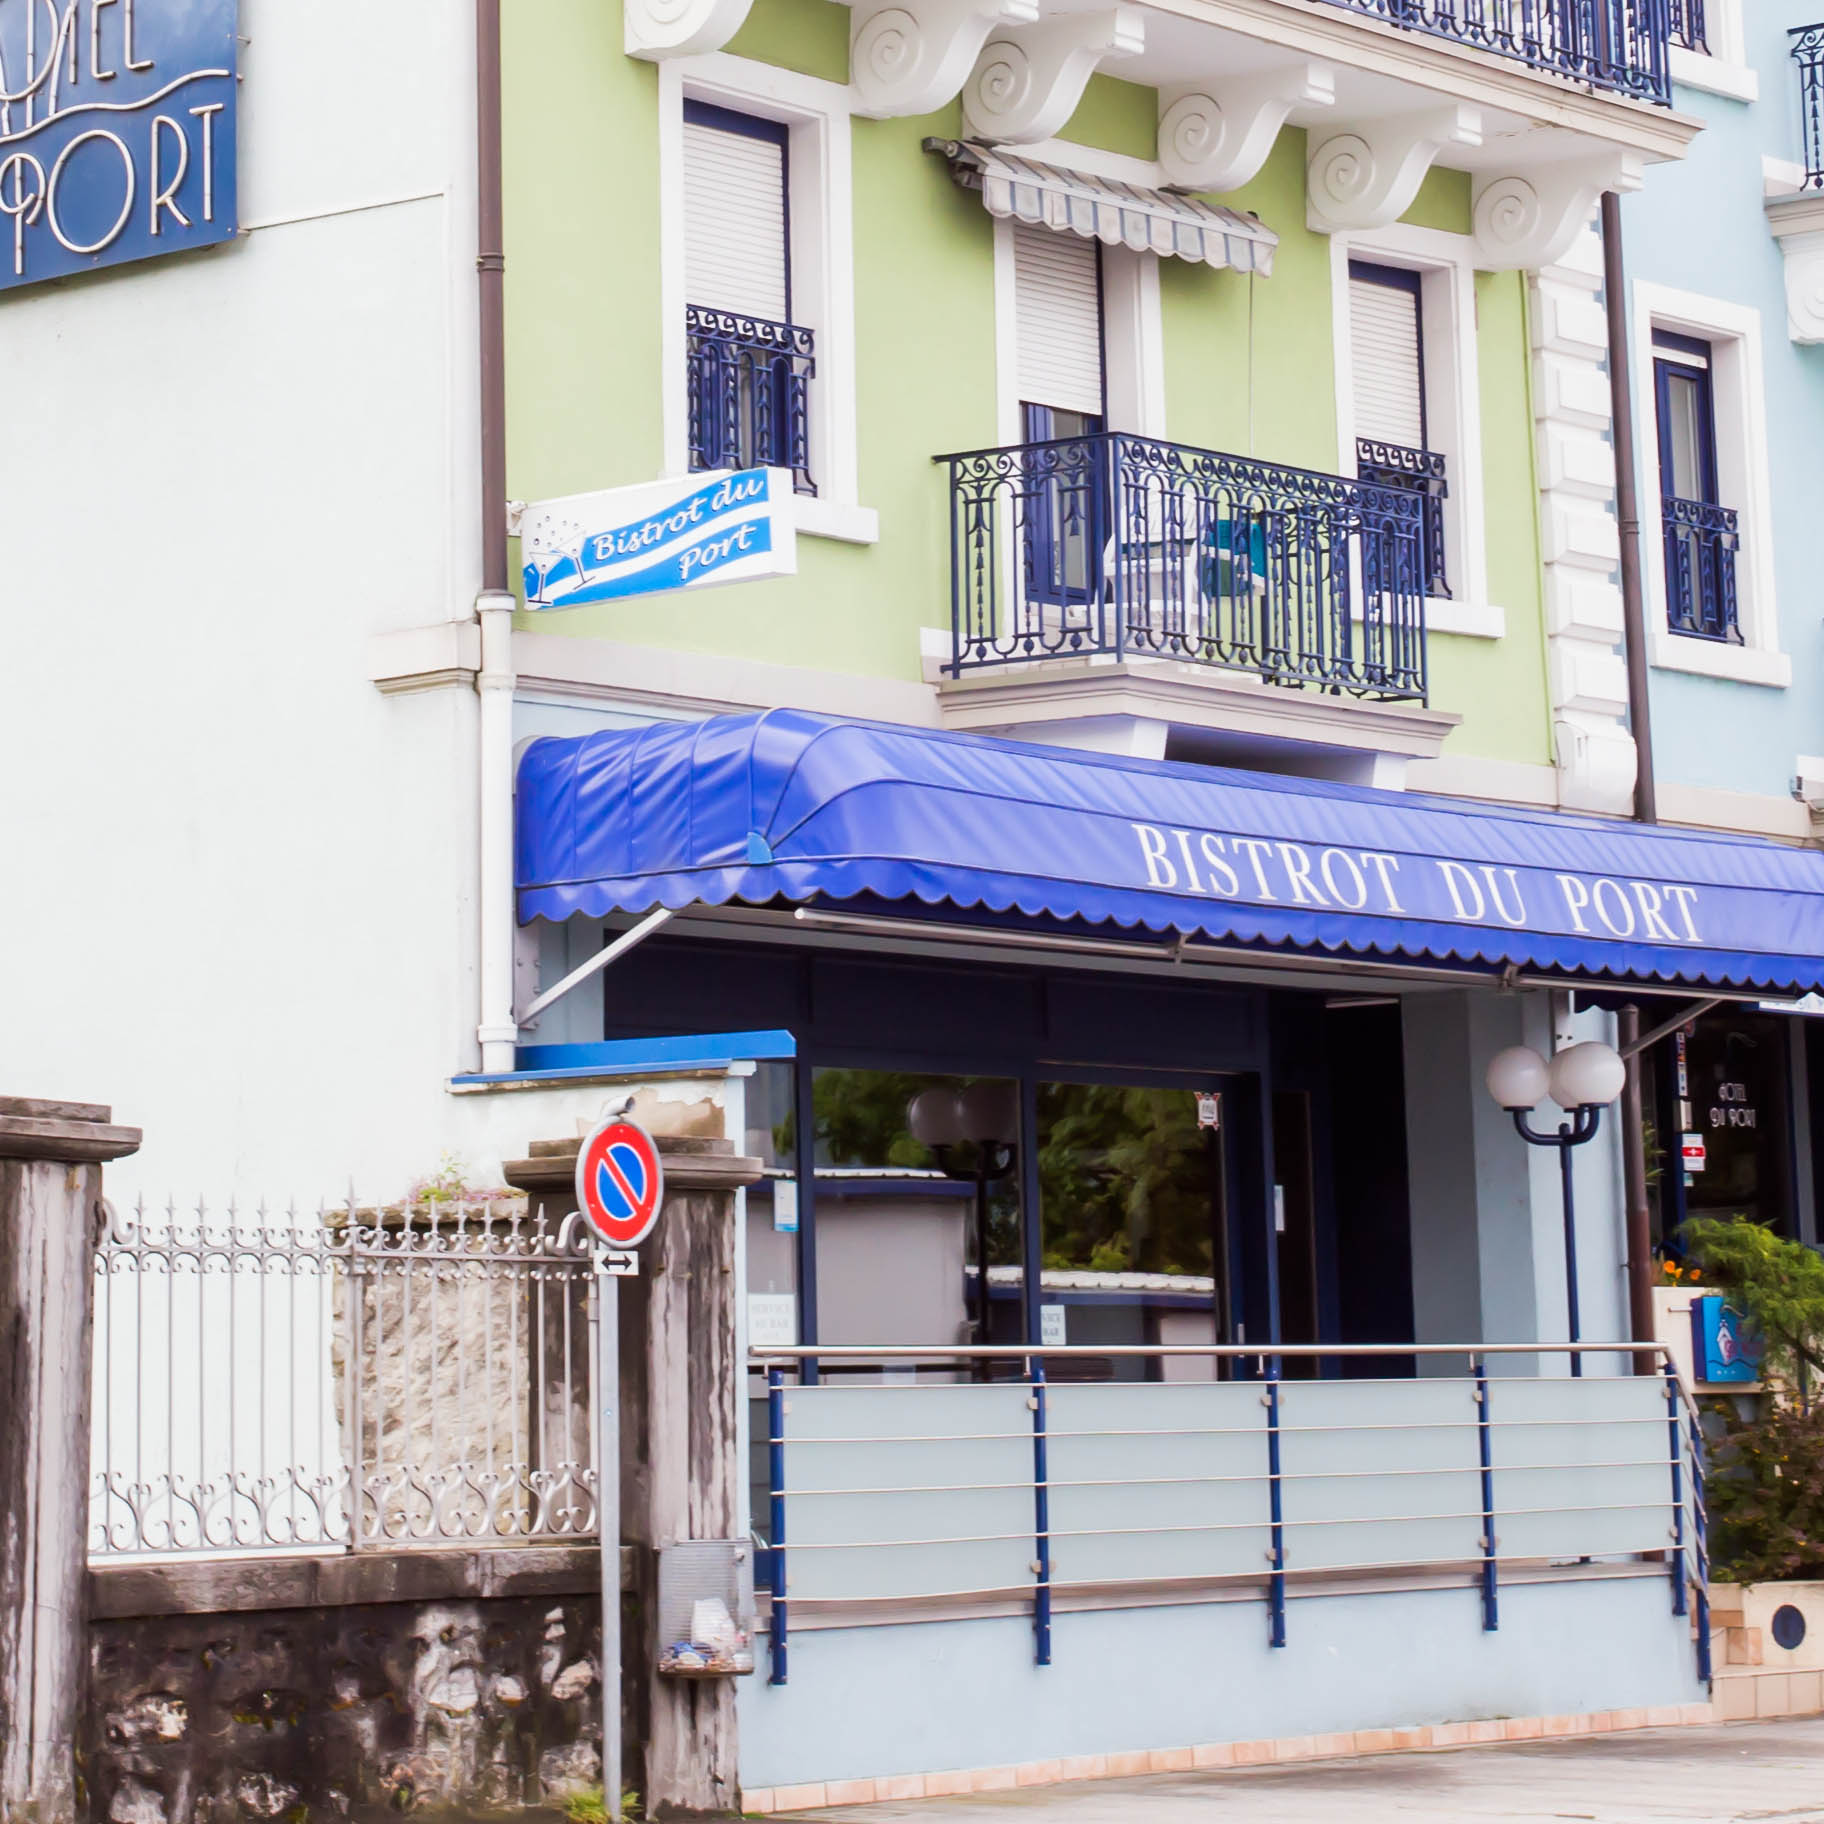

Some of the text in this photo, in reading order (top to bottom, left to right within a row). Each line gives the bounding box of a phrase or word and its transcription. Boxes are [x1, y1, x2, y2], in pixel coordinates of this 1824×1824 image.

[592, 476, 765, 561] Bistrot du
[678, 524, 758, 581] Port
[1131, 823, 1704, 944] BISTROT DU PORT
